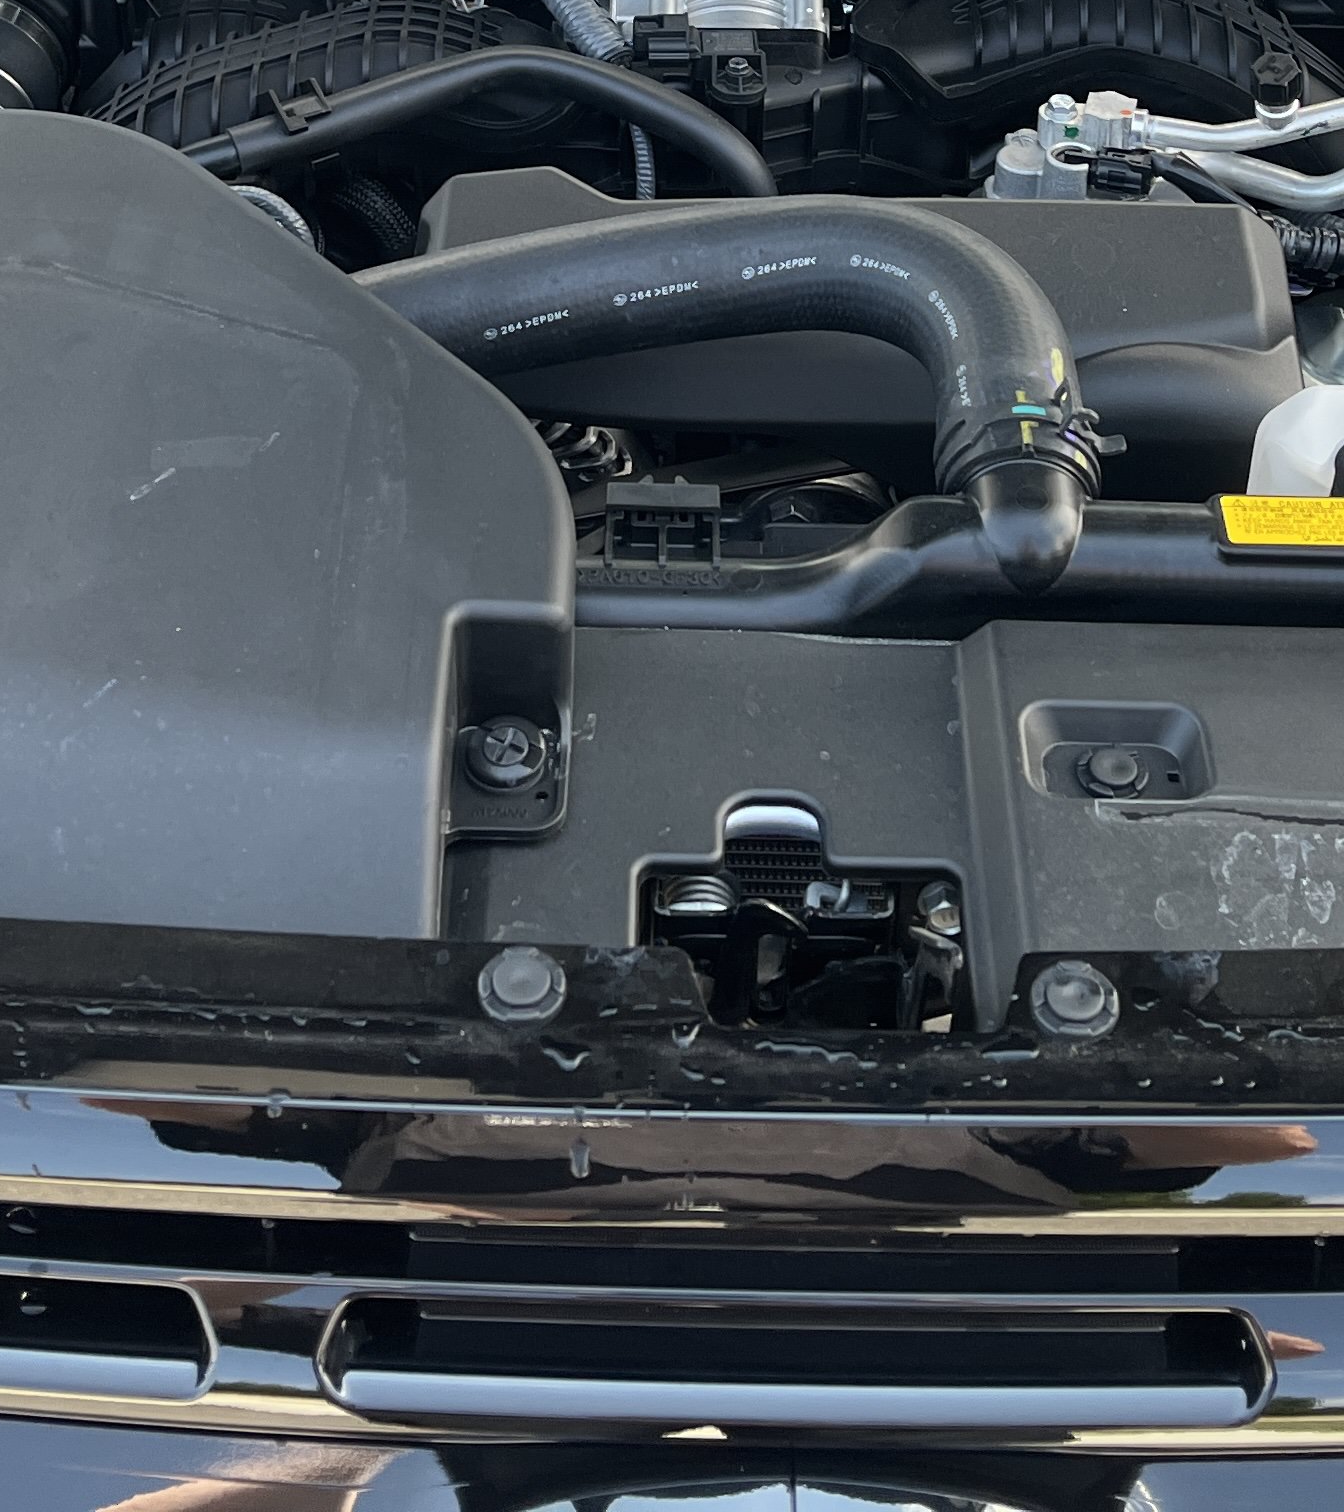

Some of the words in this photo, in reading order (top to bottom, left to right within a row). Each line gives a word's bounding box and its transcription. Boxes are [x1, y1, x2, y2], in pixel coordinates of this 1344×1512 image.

[757, 263, 780, 275] 264
[779, 257, 816, 270] >EPDM<
[630, 290, 651, 301] 264
[654, 281, 698, 296] >EPDM<
[501, 322, 522, 335] 264
[525, 309, 569, 328] >EPDM<
[1278, 500, 1323, 508] CAUTION
